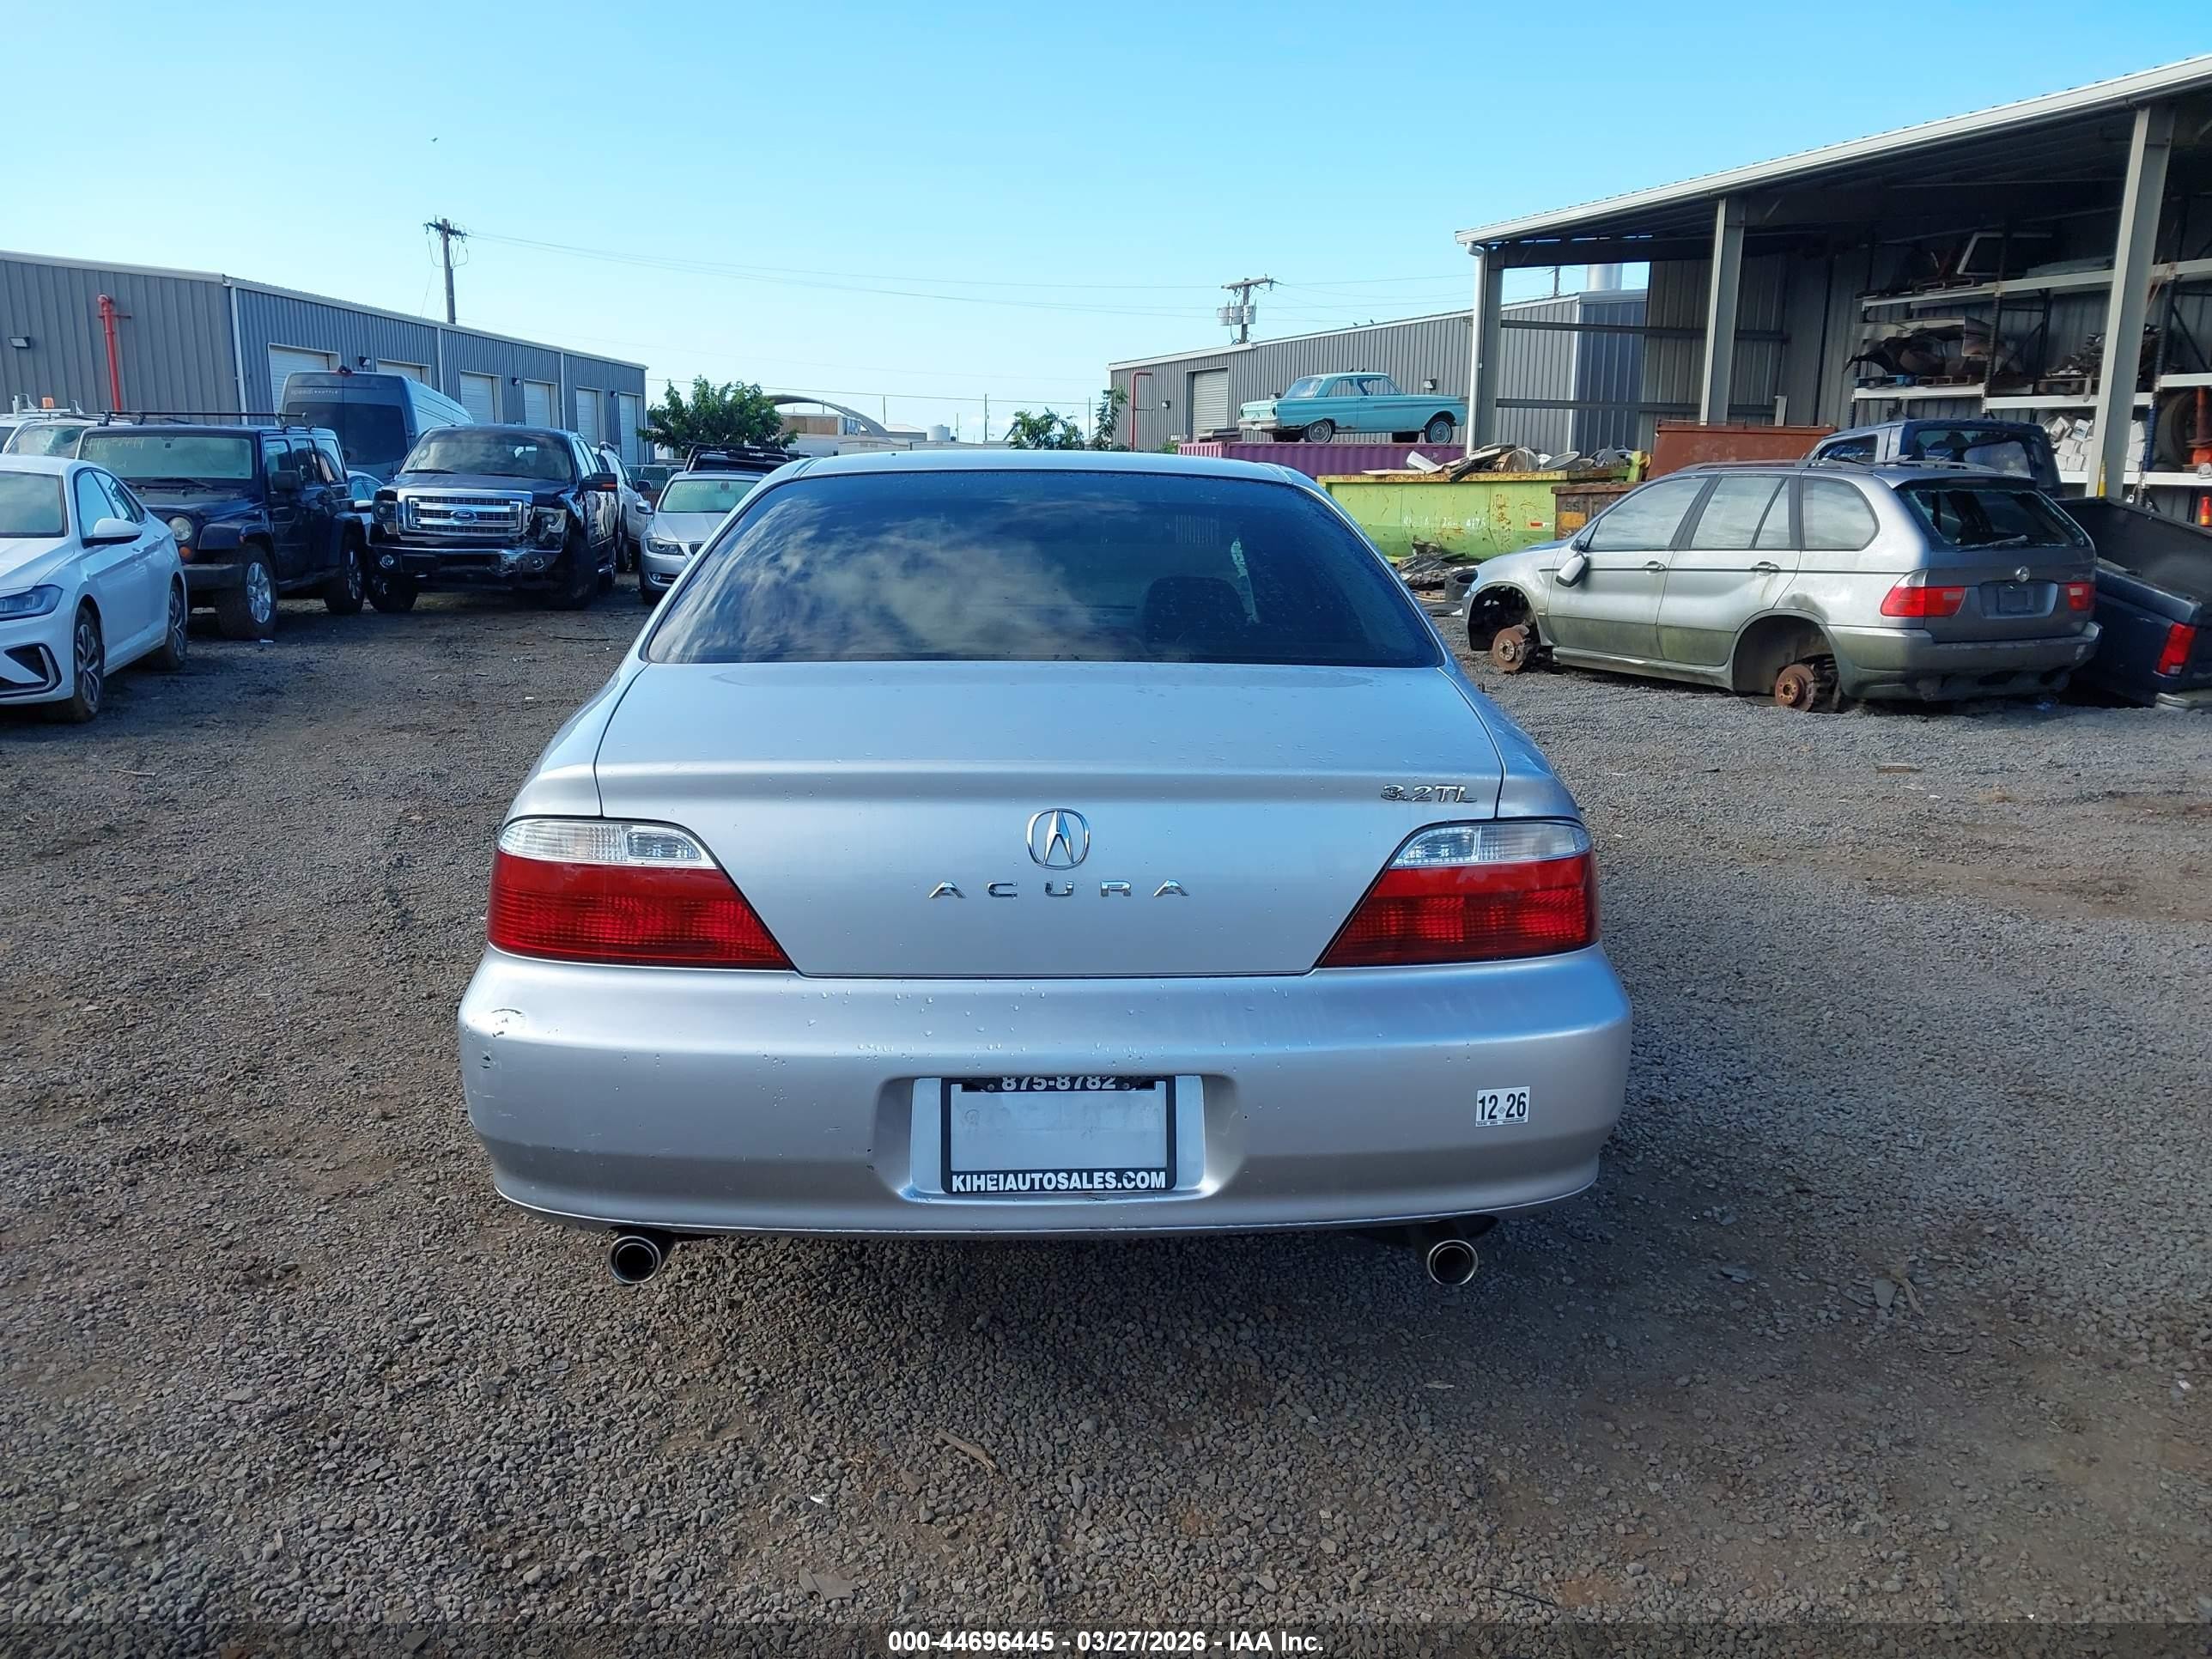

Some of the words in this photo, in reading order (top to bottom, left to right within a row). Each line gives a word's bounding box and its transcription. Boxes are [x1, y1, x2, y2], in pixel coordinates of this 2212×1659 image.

[1381, 784, 1477, 803] 3.2TL
[1478, 1094, 1498, 1121] 12
[1505, 1091, 1527, 1119] 26
[951, 1171, 1166, 1193] KIHEIAUTOSALES.COM
